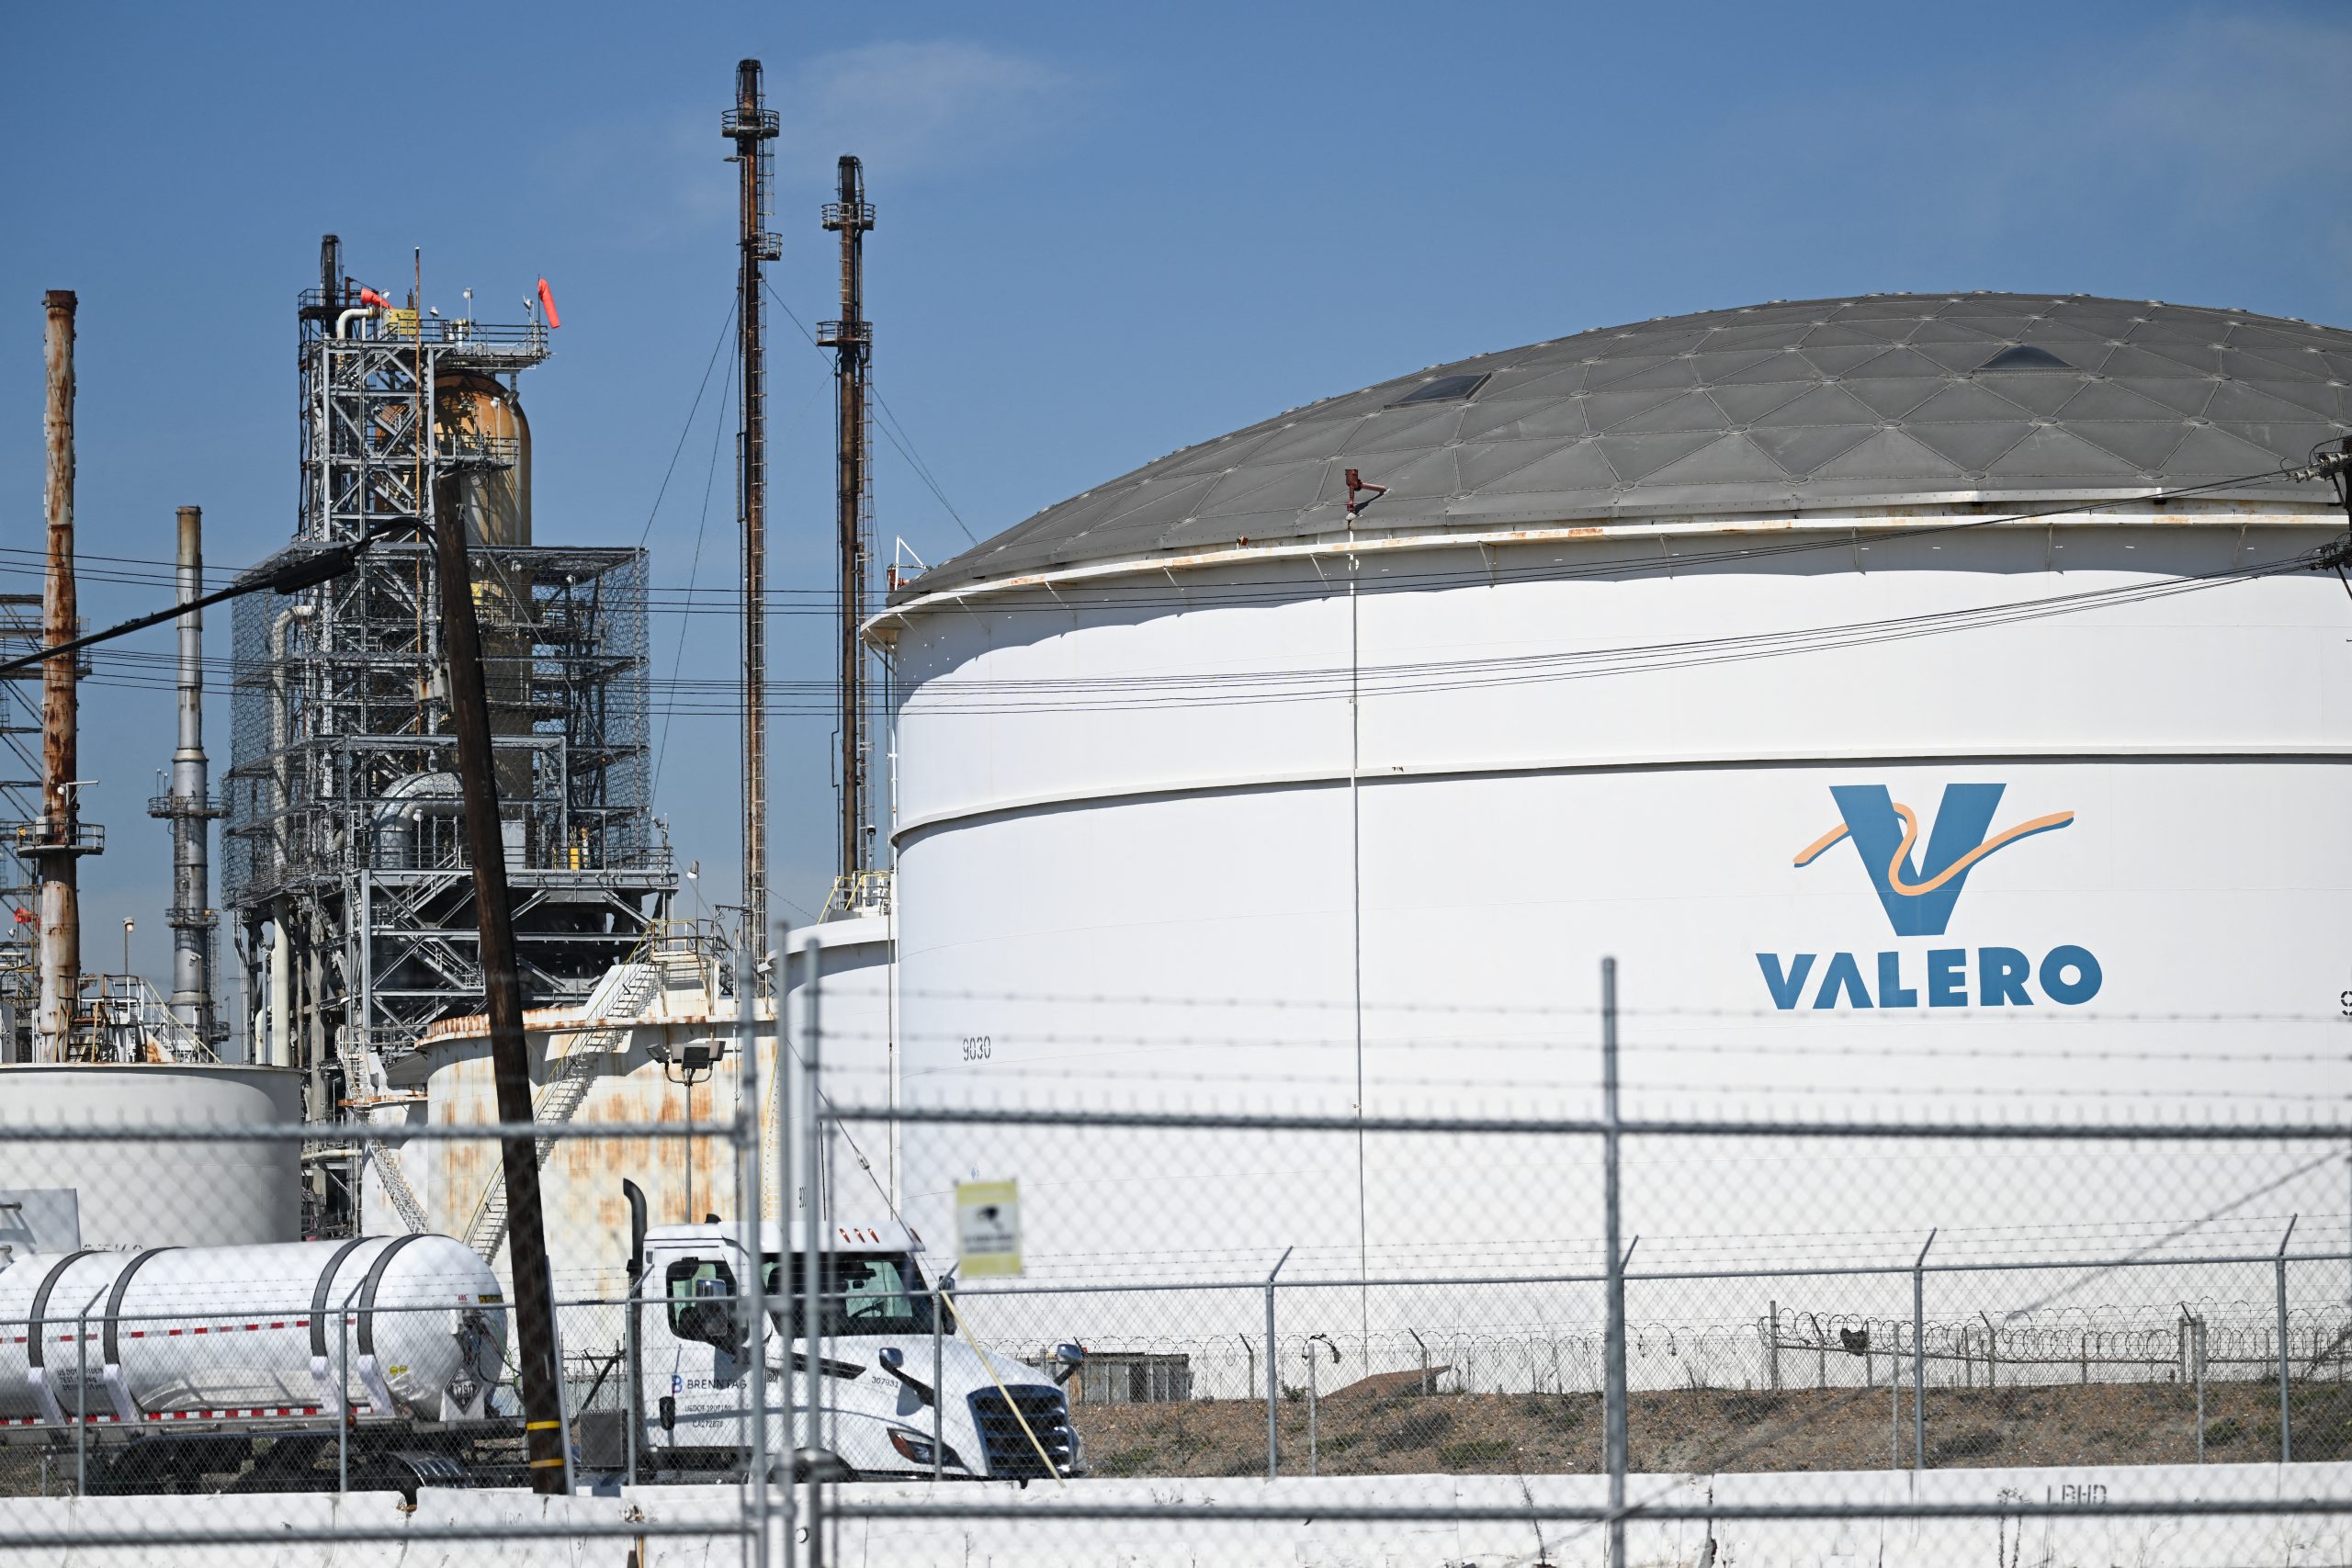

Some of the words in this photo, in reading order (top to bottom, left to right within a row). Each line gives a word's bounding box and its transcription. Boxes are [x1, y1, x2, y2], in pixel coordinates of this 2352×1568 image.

[1756, 944, 2103, 1010] VALERO
[963, 1035, 991, 1062] 9030
[687, 1379, 747, 1390] BRENNTAG
[871, 1376, 899, 1388] 307931
